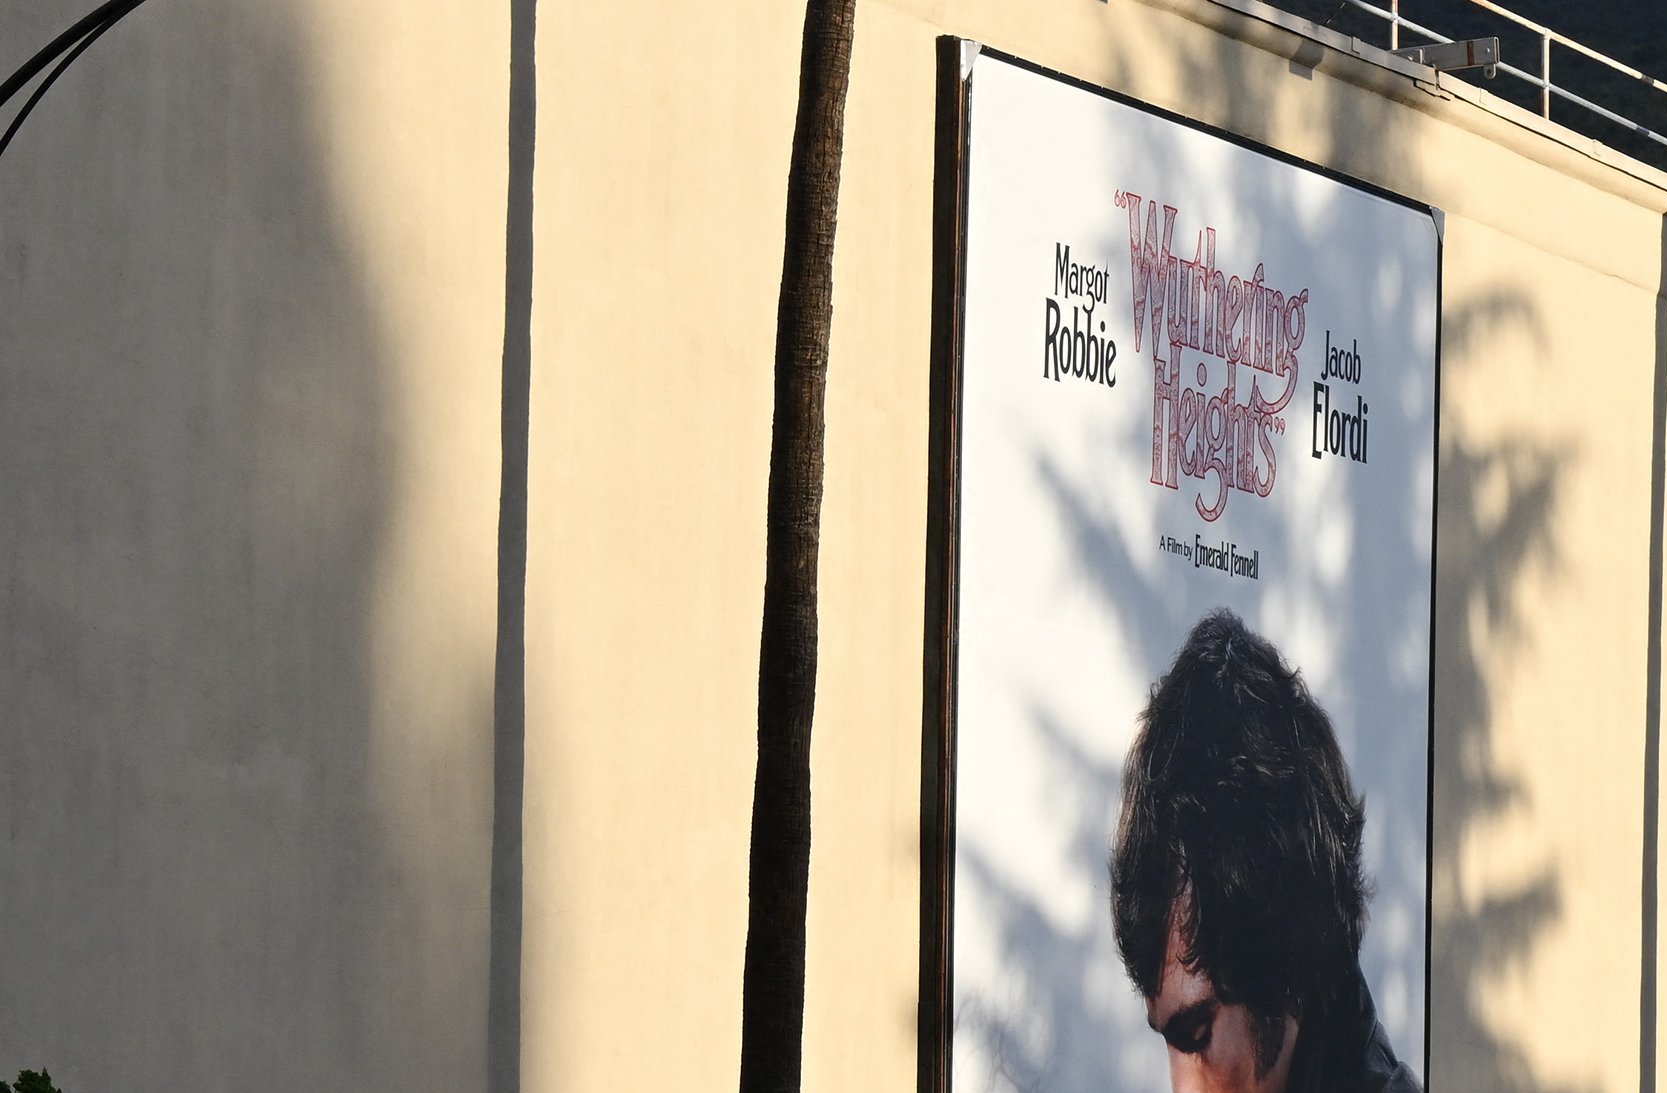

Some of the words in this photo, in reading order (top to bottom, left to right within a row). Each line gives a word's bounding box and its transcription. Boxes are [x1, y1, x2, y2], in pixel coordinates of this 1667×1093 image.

[1054, 242, 1110, 312] Margot
[1114, 189, 1309, 414] “Wuthering
[1043, 297, 1117, 388] Robbie
[1321, 330, 1362, 385] Jacob
[1150, 342, 1286, 522] Heights”
[1312, 381, 1369, 464] Elordi
[1159, 534, 1166, 551] A
[1167, 537, 1183, 556] Film
[1183, 541, 1194, 561] by
[1194, 533, 1229, 572] Emerald
[1230, 543, 1259, 580] Fennell
